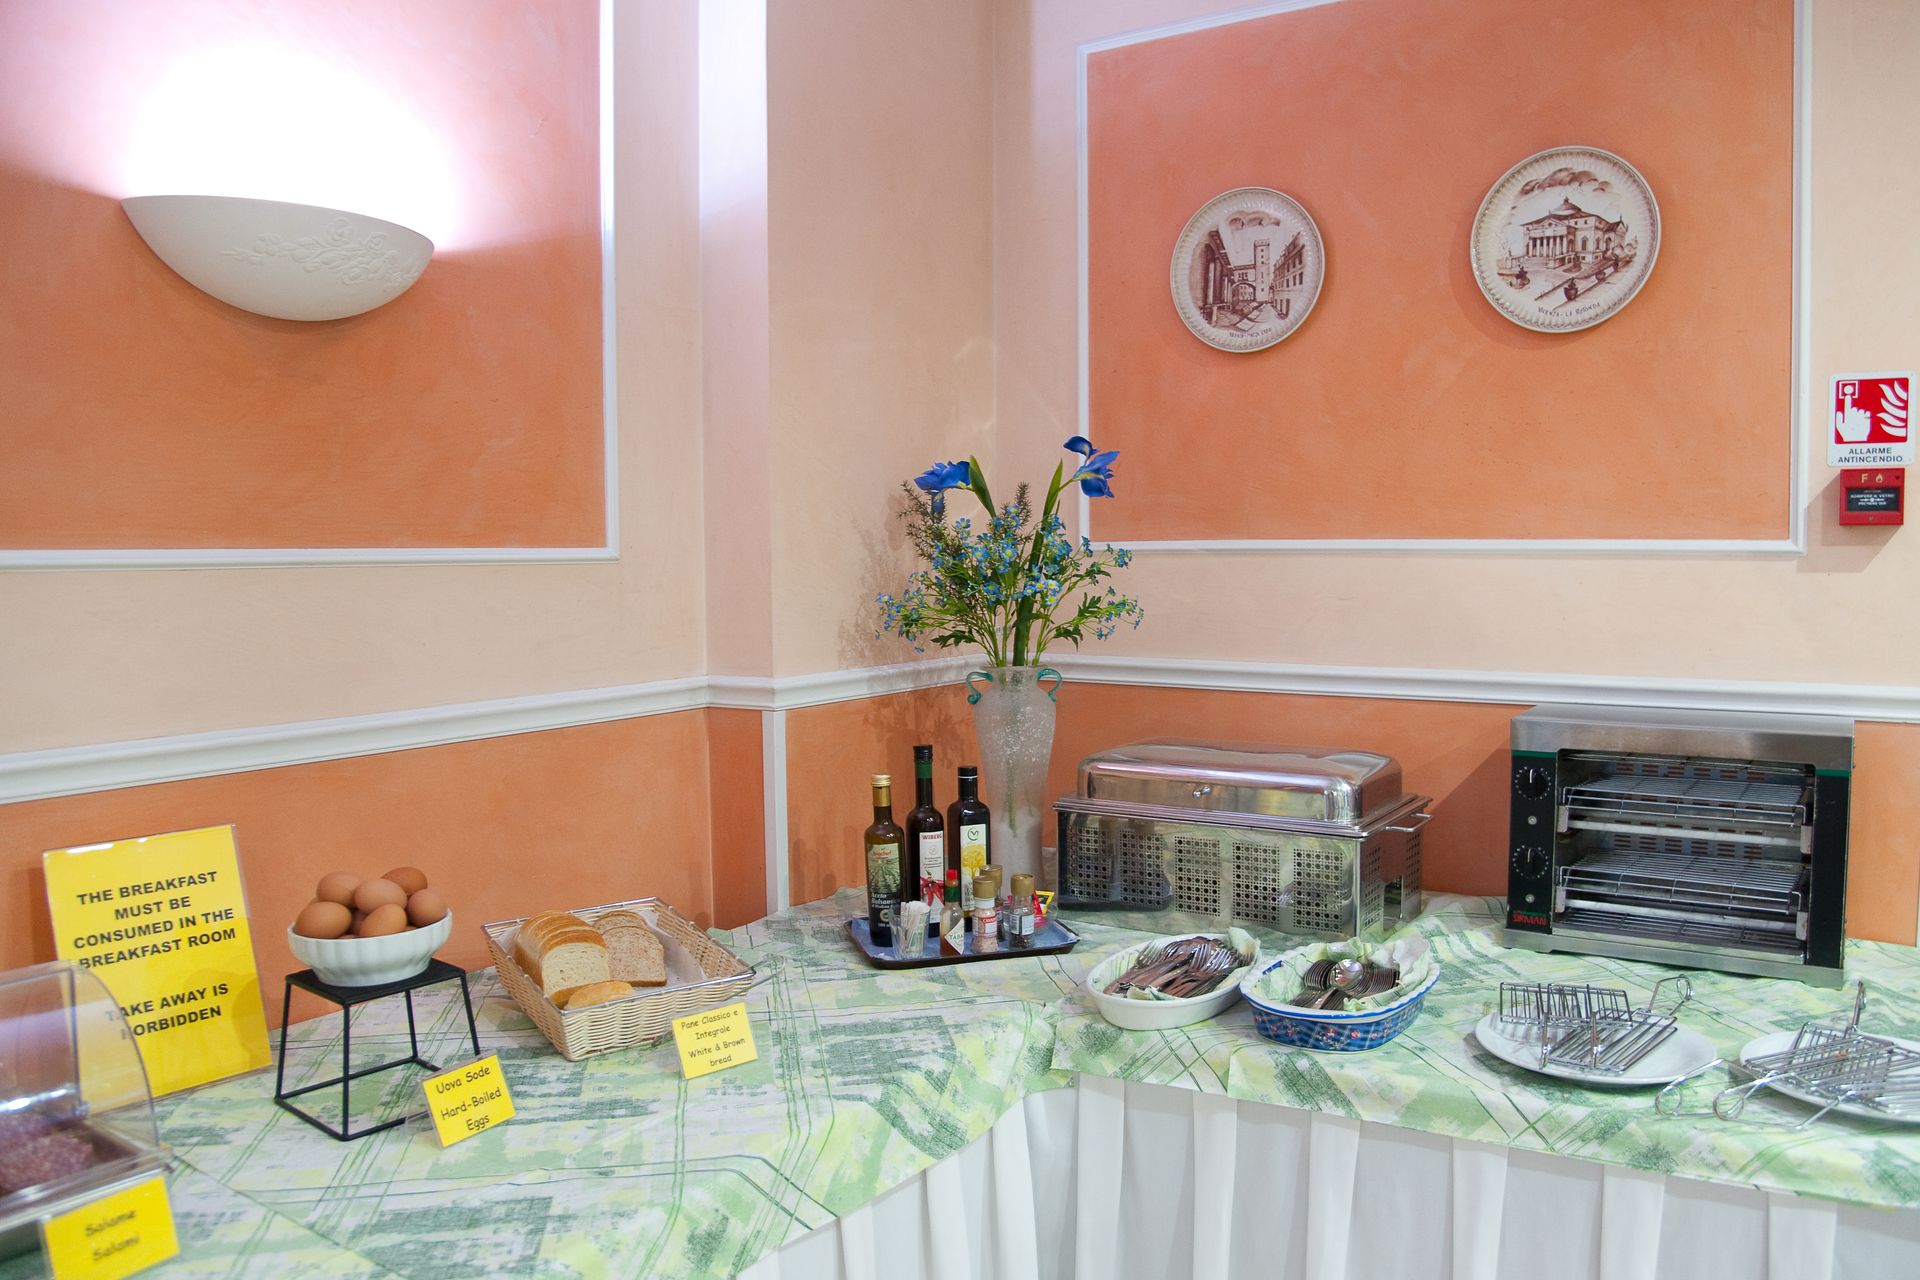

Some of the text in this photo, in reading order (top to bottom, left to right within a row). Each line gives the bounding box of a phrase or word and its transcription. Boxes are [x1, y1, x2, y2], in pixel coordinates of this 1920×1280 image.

[1838, 455, 1903, 463] ANTINCENDIO
[1848, 447, 1893, 455] ALLARME
[77, 871, 217, 905] THE BREAKFAST
[115, 896, 192, 920] MUST BE
[74, 908, 235, 949] CONSUMED IN THE
[79, 928, 236, 969] BREAKFAST ROOM
[105, 983, 229, 1022] TAKE AWAY IS
[681, 1020, 700, 1030] Pane
[701, 1012, 731, 1025] Classico
[695, 1025, 731, 1041] Integrale
[688, 1038, 746, 1059] White & Brown
[710, 1053, 732, 1066] bread
[436, 1066, 491, 1094] Uova Sode
[440, 1087, 502, 1121] Hard-Boiled
[466, 1115, 491, 1131] Eggs
